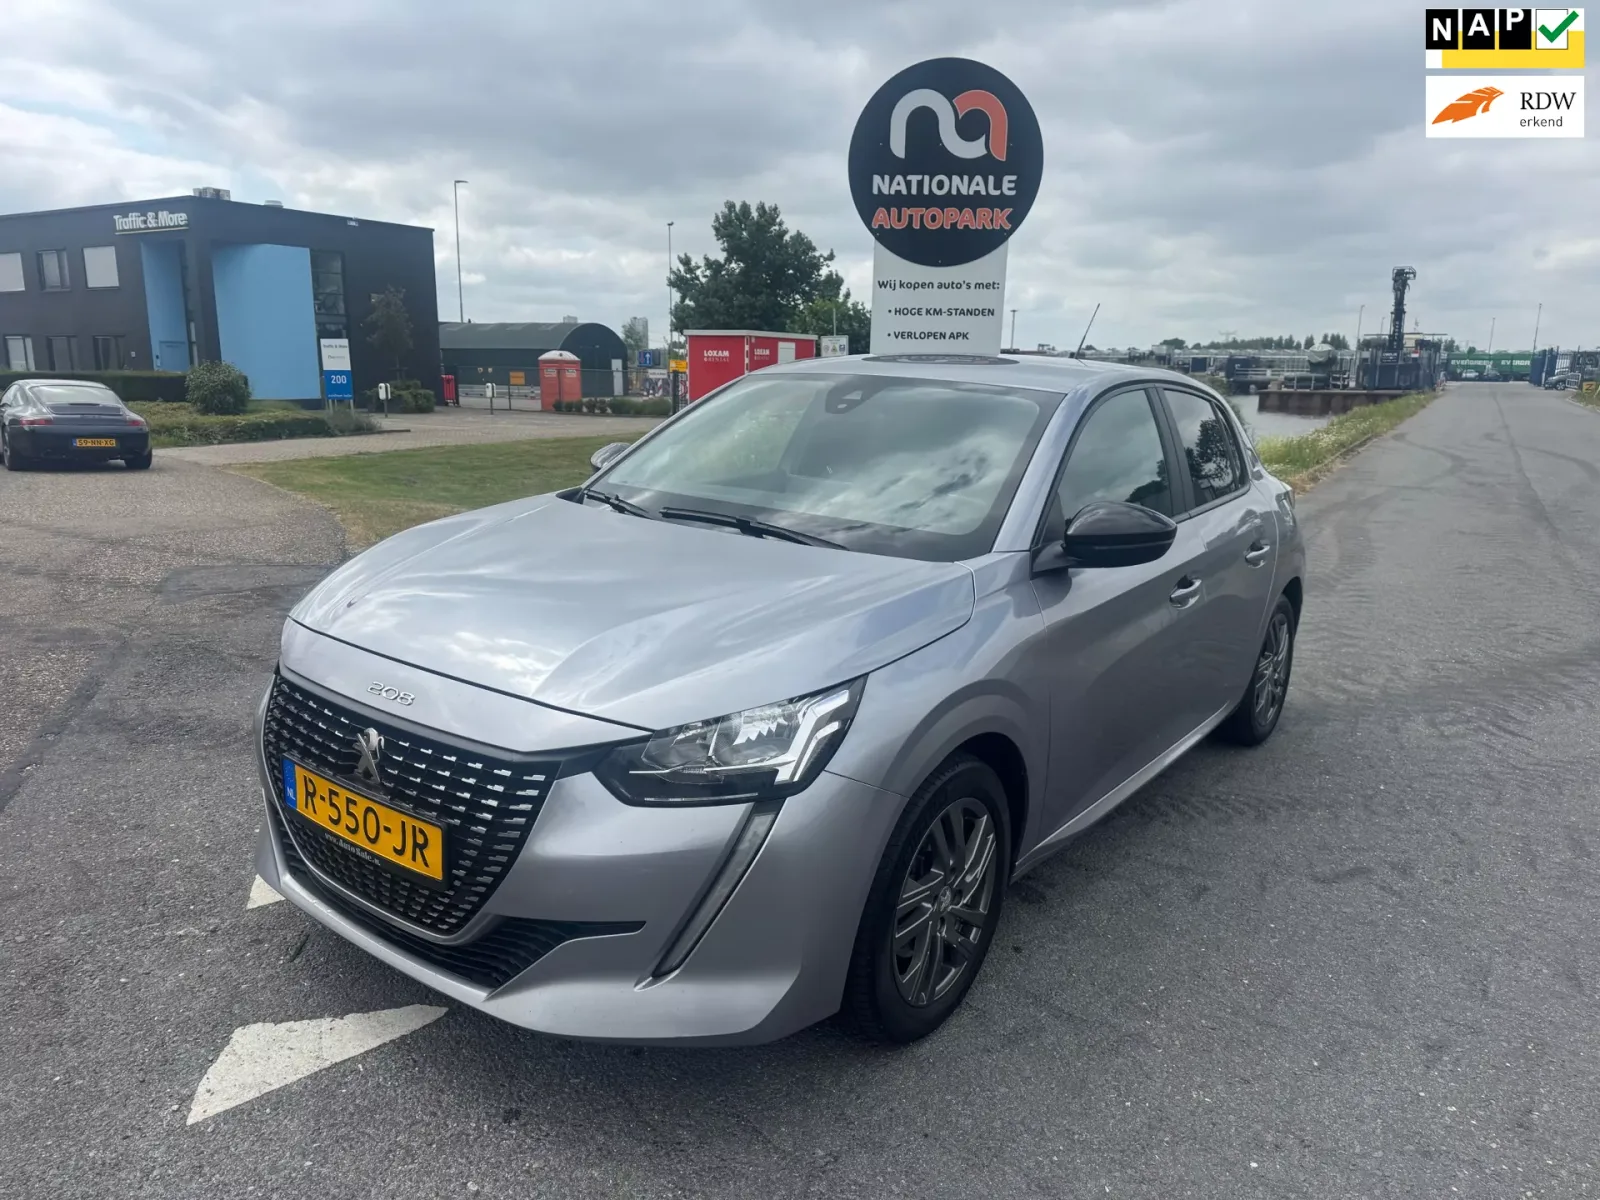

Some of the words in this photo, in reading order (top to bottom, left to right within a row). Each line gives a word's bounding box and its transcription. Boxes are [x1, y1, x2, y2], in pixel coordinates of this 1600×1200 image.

[872, 174, 1018, 196] NATIONALE
[112, 212, 147, 231] Traffic
[146, 211, 158, 229] &
[157, 210, 189, 228] More
[871, 207, 1014, 230] AUTOPARK
[877, 279, 897, 291] Wij
[898, 280, 934, 291] kopen
[936, 280, 972, 290] auto's
[974, 281, 1000, 290] met:
[894, 307, 923, 316] HOGE
[925, 308, 995, 317] KM-STANDEN
[893, 331, 946, 340] VERLOPEN
[948, 332, 970, 340] APK
[330, 375, 347, 384] 200
[367, 681, 416, 706] 208
[303, 774, 430, 868] R-550-JR
